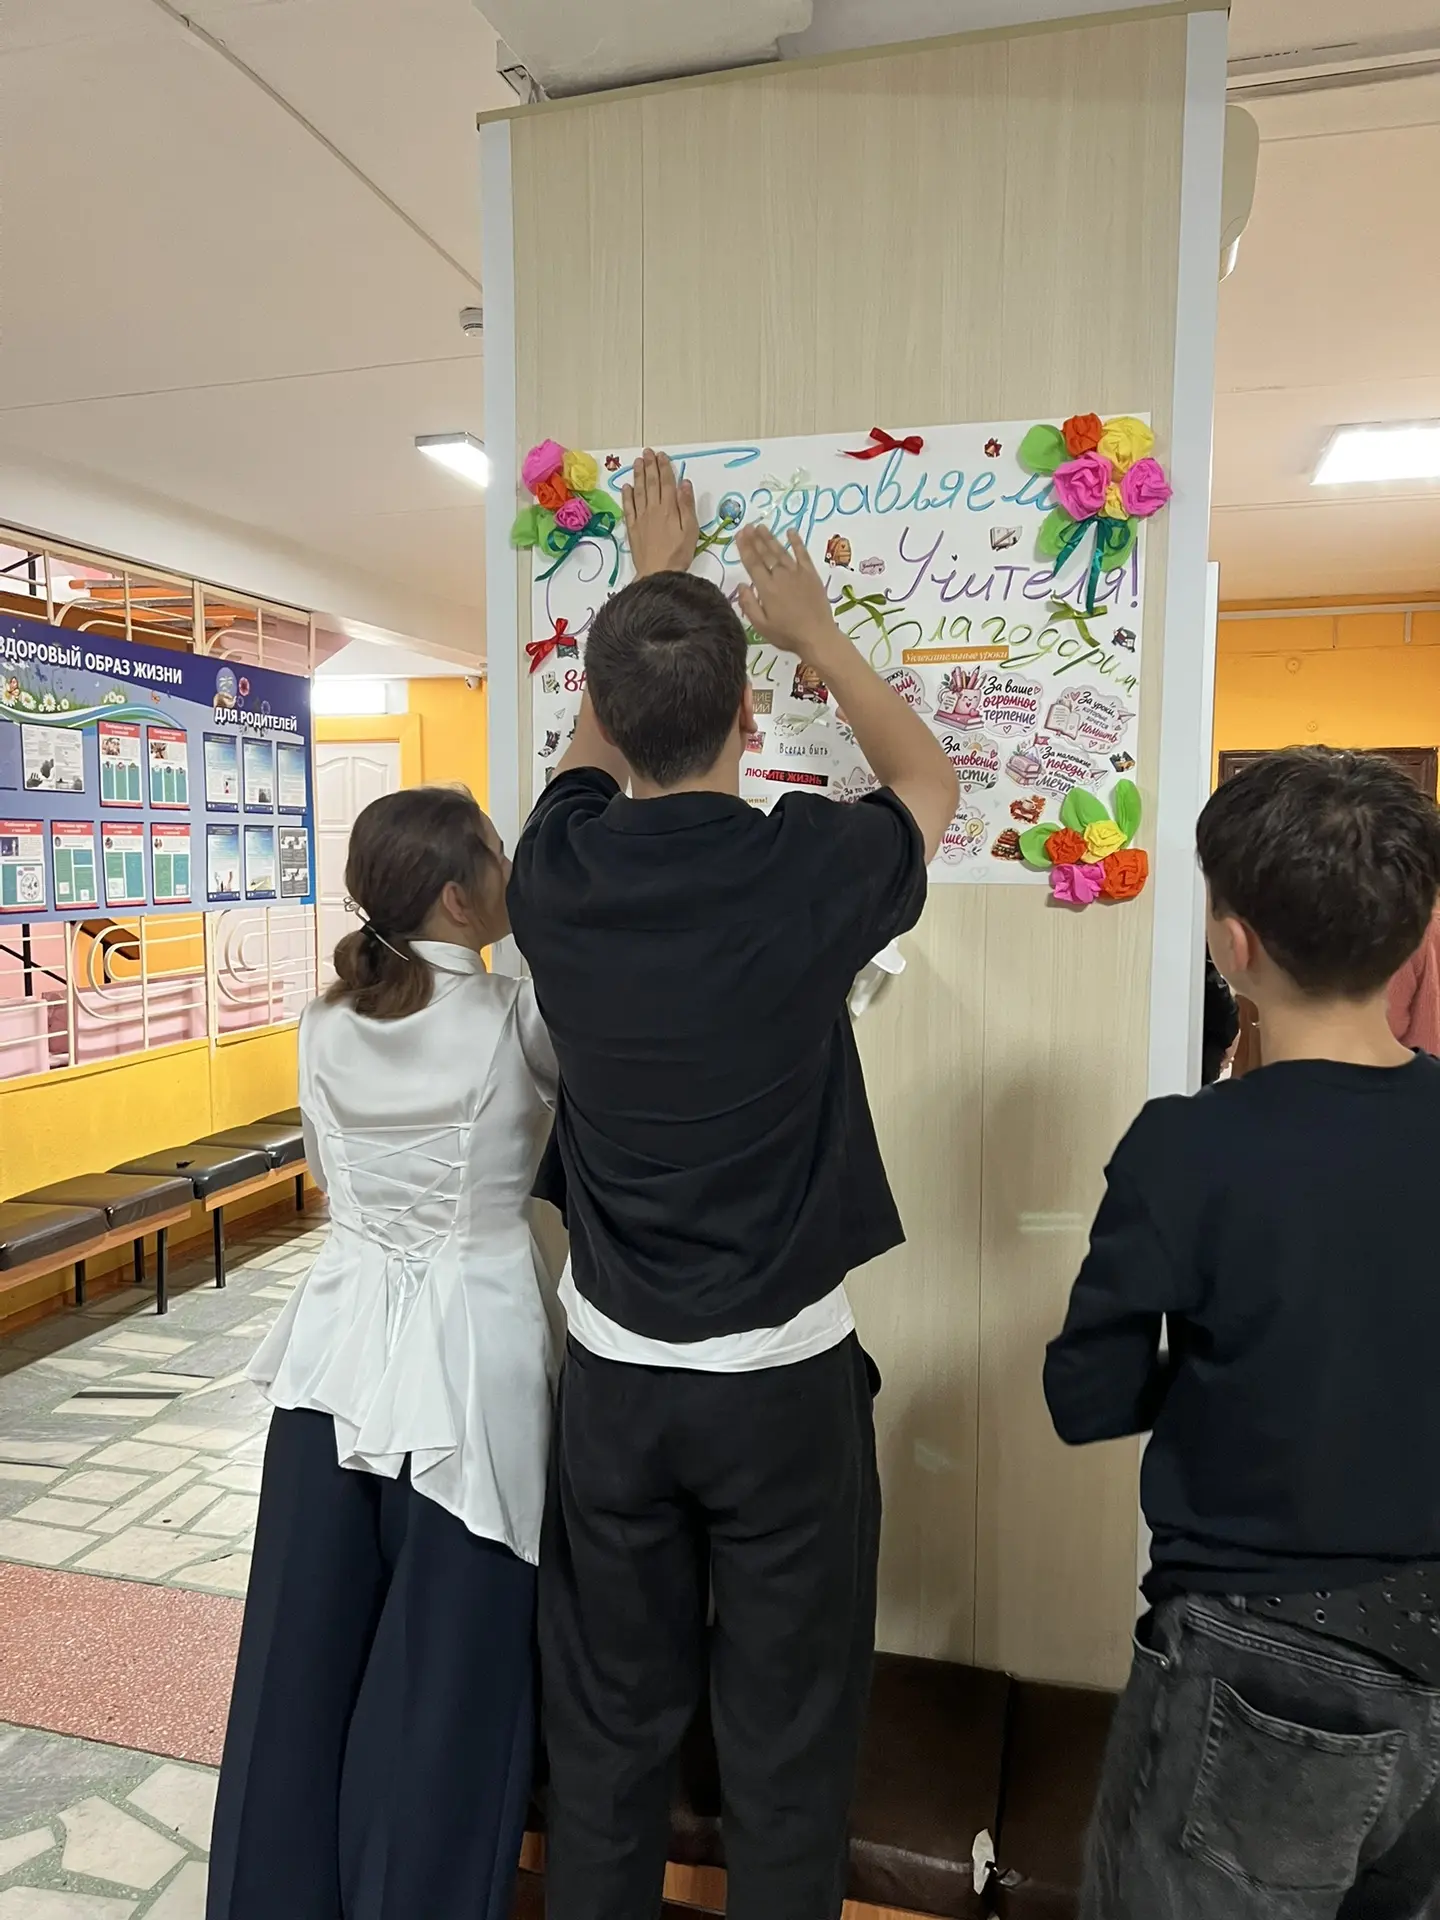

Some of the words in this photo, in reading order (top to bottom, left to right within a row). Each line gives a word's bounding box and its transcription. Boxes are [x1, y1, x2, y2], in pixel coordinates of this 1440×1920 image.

[0, 636, 82, 668] ЗДОРОВЫЙ
[85, 652, 131, 676] ОБРАЗ
[132, 661, 183, 685] ЖИЗНИ
[904, 651, 977, 664] Увлекательные
[979, 650, 1008, 662] уроки
[983, 675, 1003, 695] За
[1004, 678, 1034, 696] ваше
[983, 694, 1037, 712] огромное
[1078, 691, 1092, 704] За
[214, 707, 238, 723] ДЛЯ
[240, 710, 297, 732] РОДИТЕЛЕЙ
[983, 709, 1036, 726] терпение
[779, 742, 806, 756] Всегда
[808, 743, 828, 756] быть
[942, 735, 960, 753] За
[1042, 745, 1055, 760] За
[950, 750, 999, 771] хновение
[1045, 758, 1086, 780] победы
[744, 767, 785, 781] ЛЮБИТЕ
[786, 772, 823, 785] ЖИЗНЬ
[957, 770, 989, 784] асти
